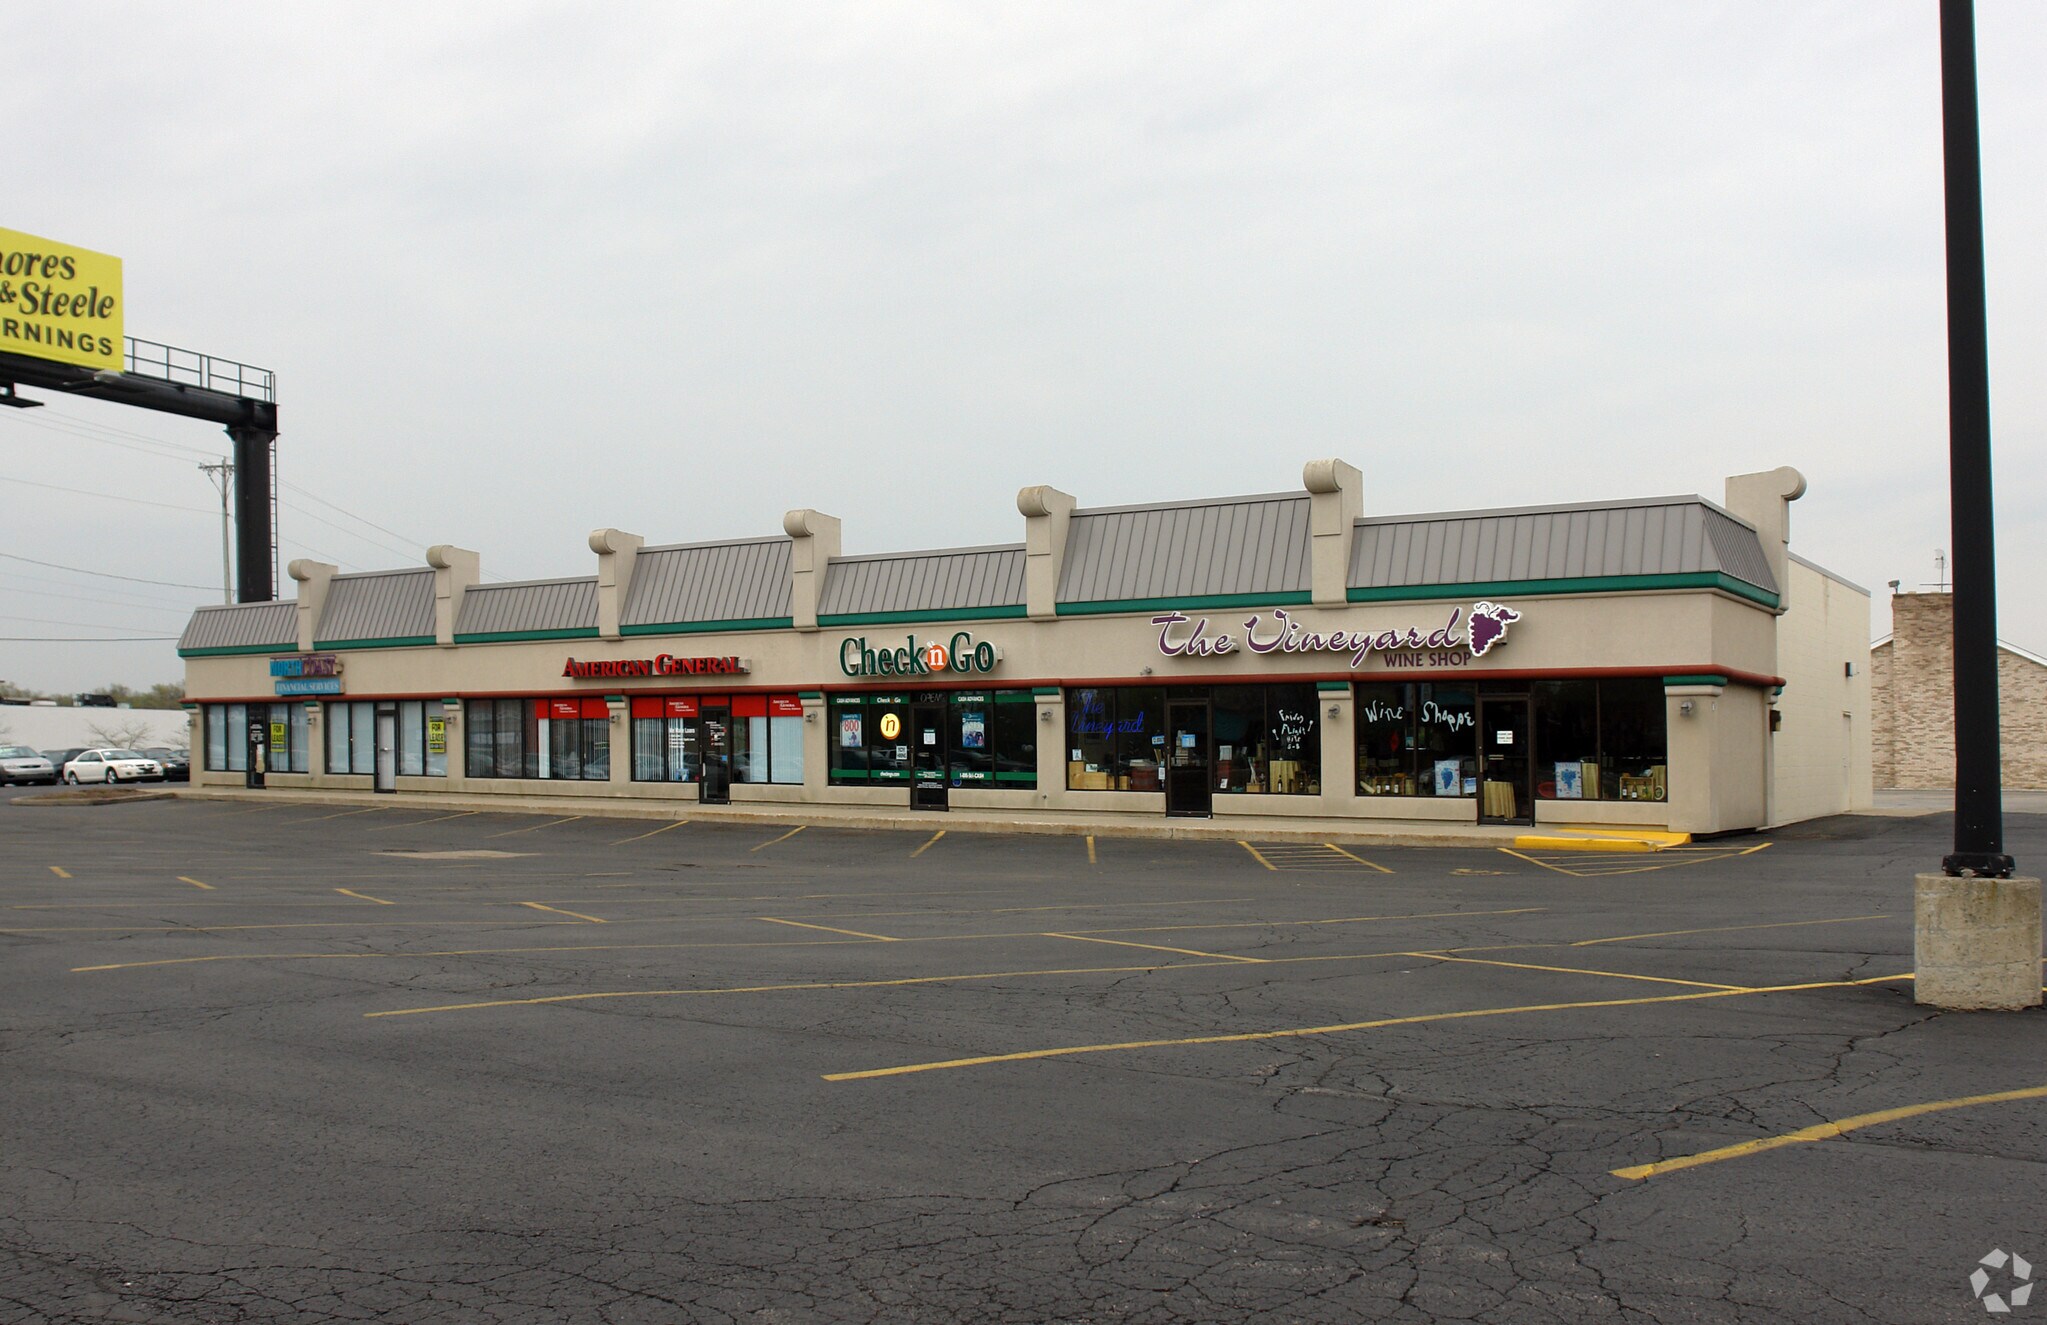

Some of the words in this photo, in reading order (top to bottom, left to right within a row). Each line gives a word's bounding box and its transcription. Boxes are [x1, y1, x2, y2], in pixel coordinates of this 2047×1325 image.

[0, 250, 76, 280] ores
[1151, 611, 1233, 657] The
[1243, 607, 1463, 669] Vineyard
[562, 656, 651, 678] AMERICAN
[654, 653, 742, 675] GENERAL
[839, 634, 928, 677] Check
[950, 631, 995, 674] Go
[1384, 653, 1423, 668] WINE
[1429, 652, 1472, 667] SHOP
[1365, 699, 1404, 723] Wine
[431, 723, 442, 732] FOR
